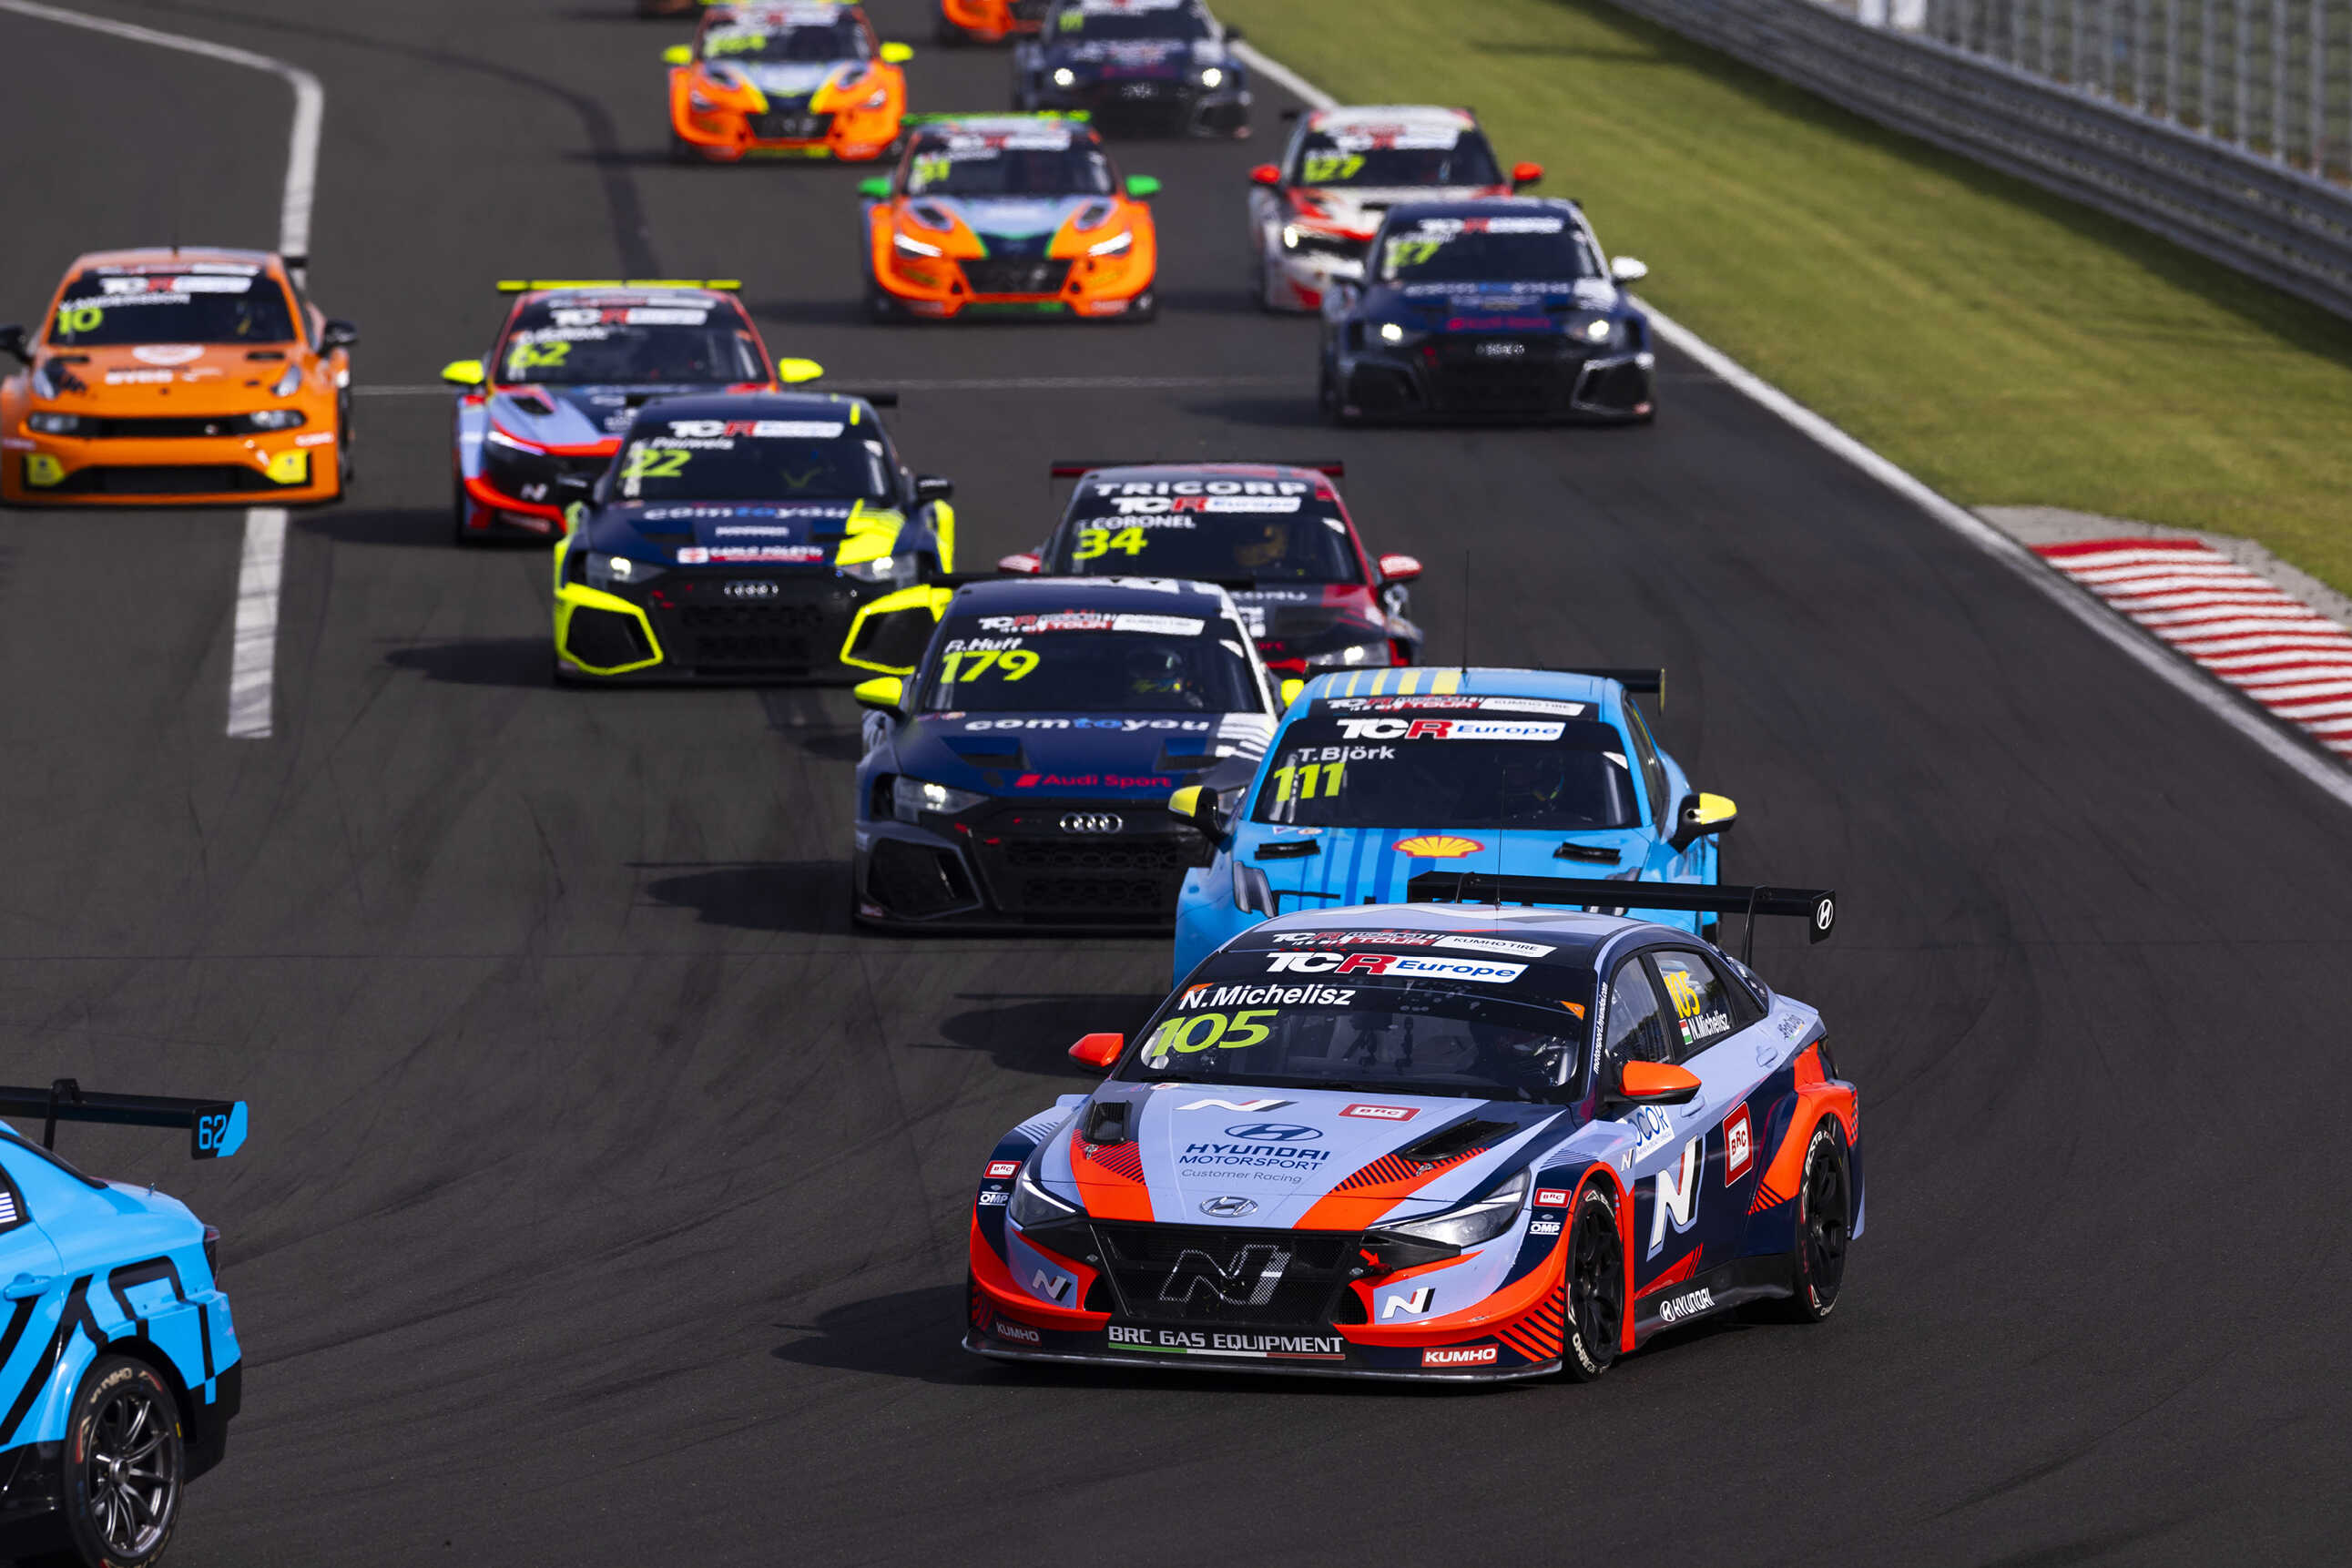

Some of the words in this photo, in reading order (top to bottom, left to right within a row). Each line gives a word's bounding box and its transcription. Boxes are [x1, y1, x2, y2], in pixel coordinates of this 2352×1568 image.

[57, 307, 104, 334] 10
[1095, 481, 1308, 496] TRICORP
[1110, 497, 1207, 514] TCR
[1073, 527, 1148, 559] 34
[940, 649, 1040, 684] 179
[965, 717, 1210, 730] comtoyou
[1337, 718, 1453, 739] TCR
[1457, 725, 1559, 736] Europe
[1298, 746, 1396, 763] T.Björk
[1043, 775, 1098, 786] Audi
[1105, 775, 1172, 788] Sport
[1273, 762, 1346, 801] 111
[1273, 932, 1345, 943] TCR
[1453, 937, 1510, 948] KUMHO
[1512, 942, 1539, 951] TIRE
[1267, 952, 1397, 975] TCR
[1397, 960, 1519, 978] Europe
[1178, 984, 1356, 1010] N.Michelisz
[1664, 971, 1701, 1019] 105
[1151, 1009, 1279, 1057] 105
[1688, 1010, 1730, 1040] N.Michelisz
[199, 1114, 227, 1150] 62
[1185, 1144, 1331, 1161] HYUNDAI
[1731, 1130, 1746, 1156] BRC
[1179, 1156, 1323, 1171] MOTORSPORT
[1181, 1168, 1251, 1181] Customer
[1253, 1172, 1302, 1184] Racing
[980, 1194, 1009, 1204] OMP
[1530, 1224, 1560, 1232] OMP
[1672, 1287, 1716, 1318] HYUNDAI
[996, 1321, 1039, 1342] KUMHO
[1108, 1326, 1152, 1344] BRC
[1159, 1330, 1206, 1348] GAS
[1213, 1334, 1344, 1352] EQUIPMENT
[1425, 1349, 1496, 1363] KUMHO
